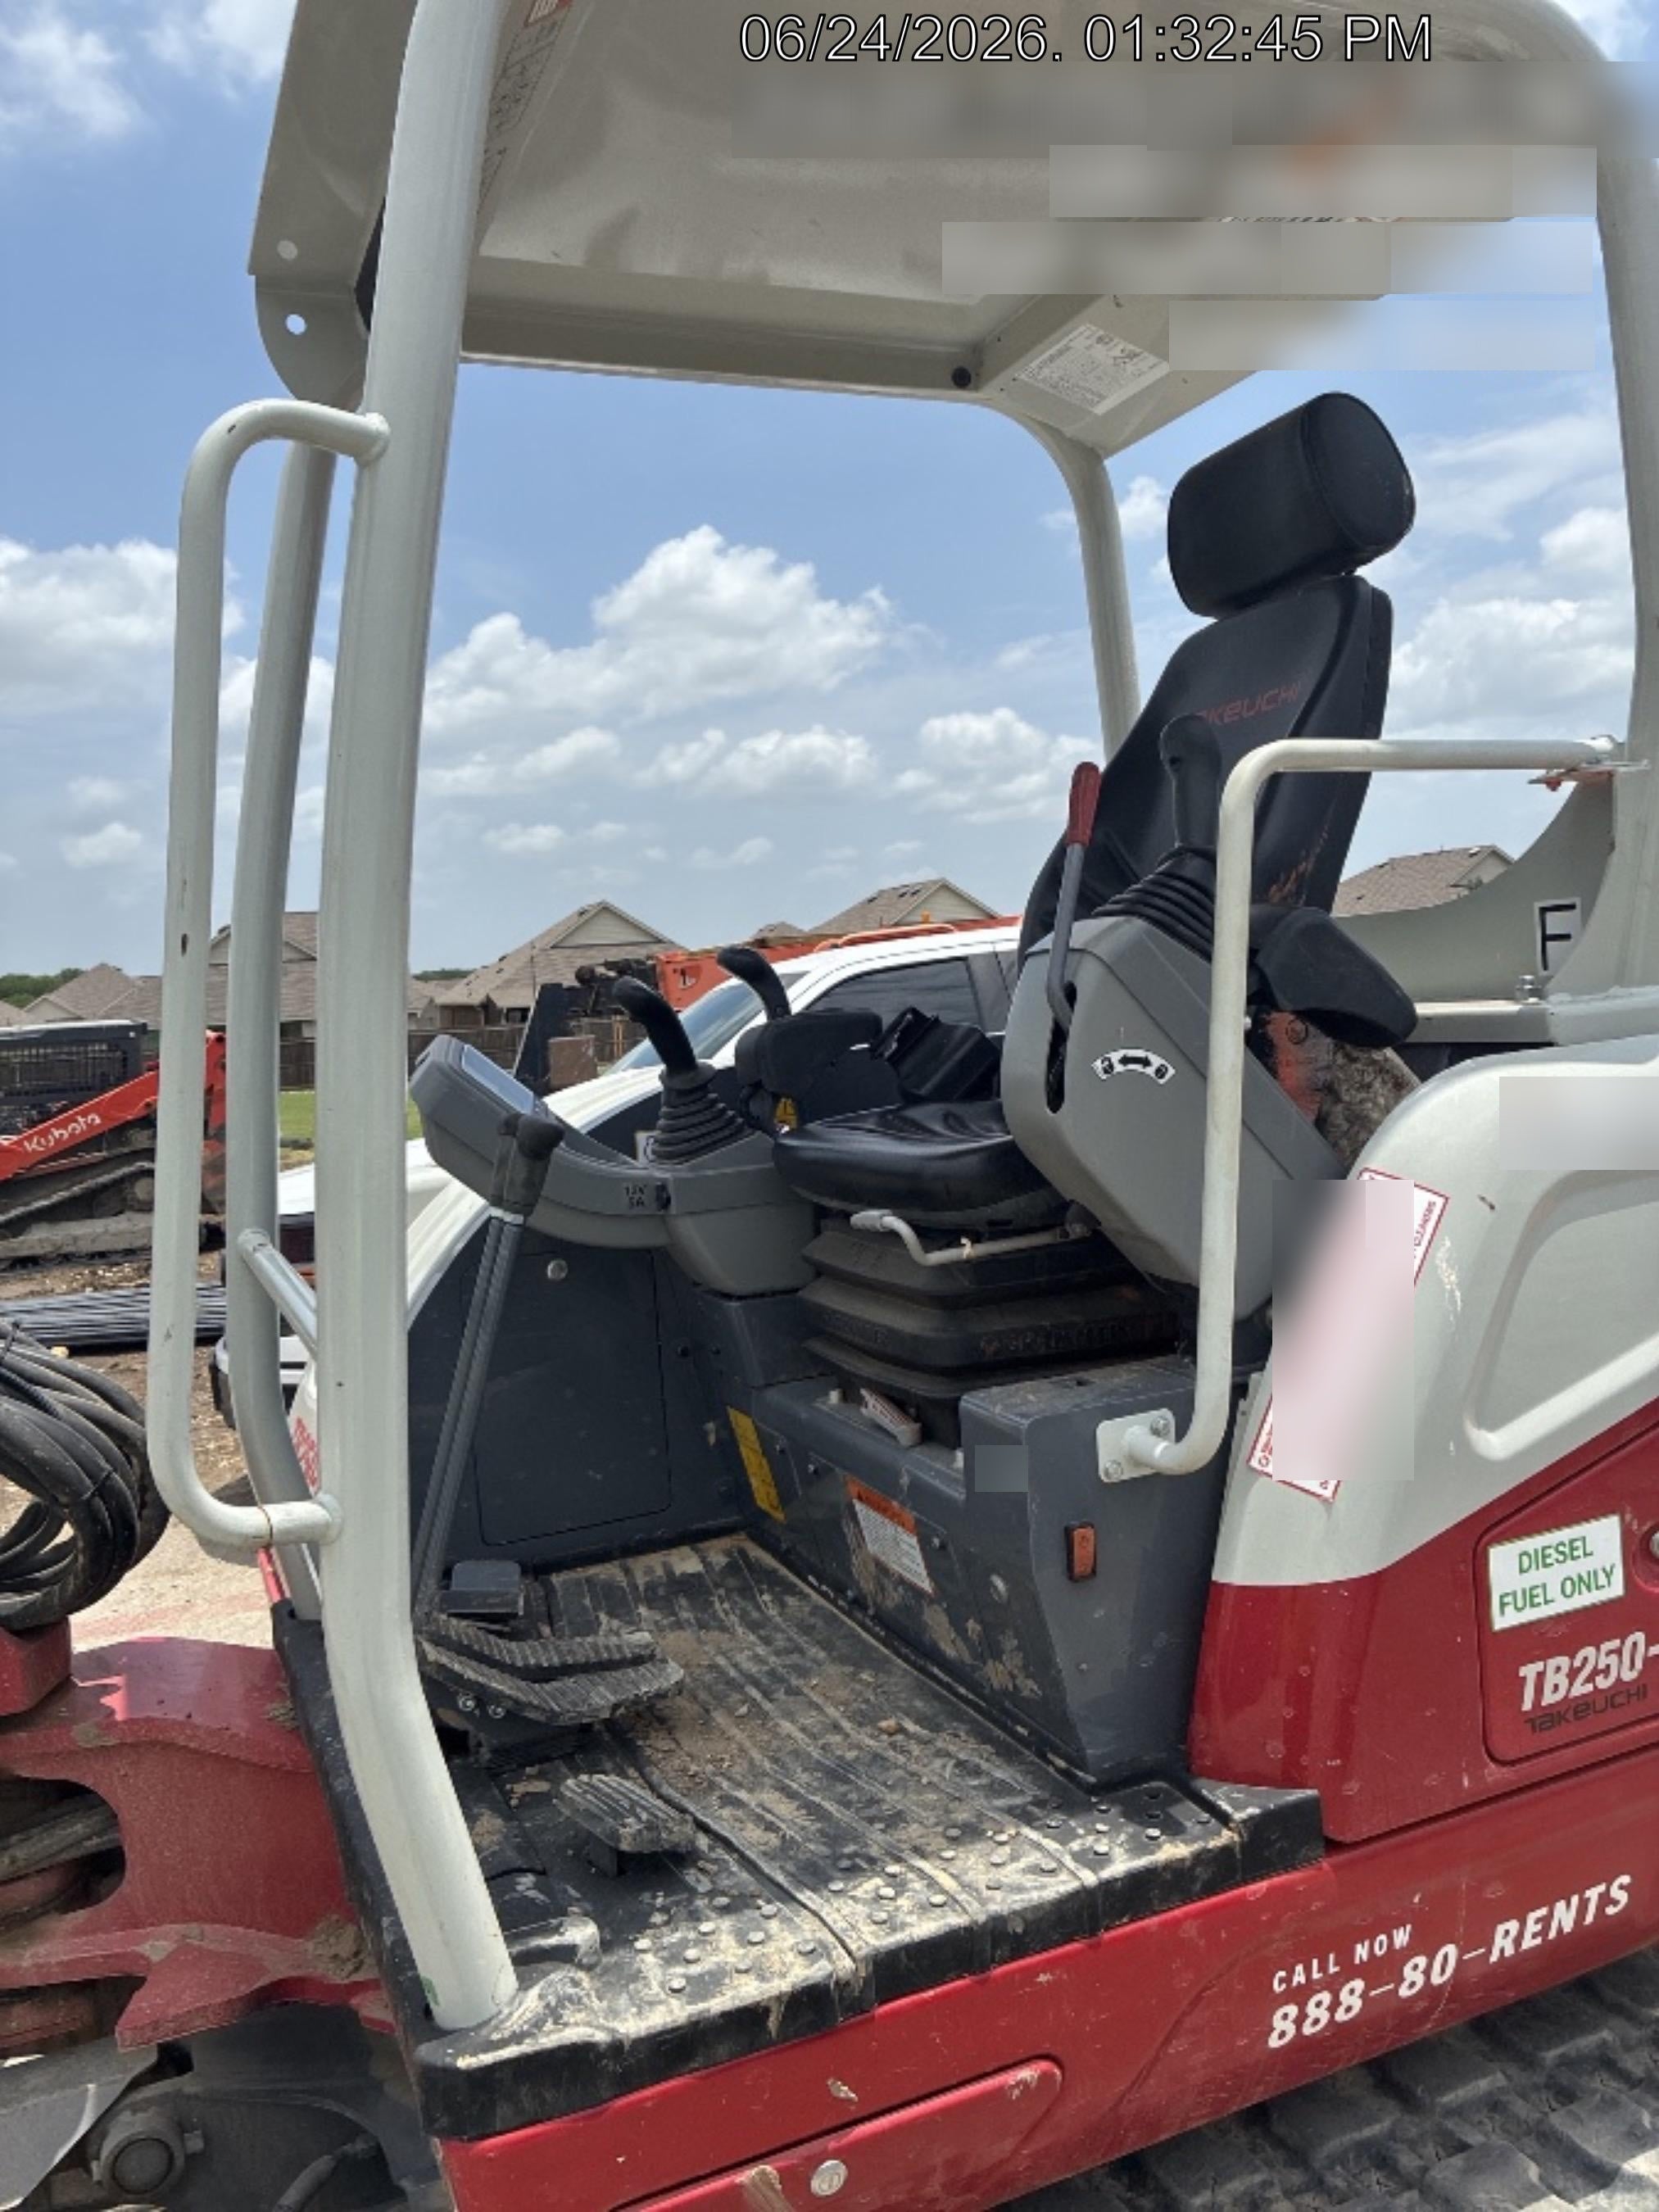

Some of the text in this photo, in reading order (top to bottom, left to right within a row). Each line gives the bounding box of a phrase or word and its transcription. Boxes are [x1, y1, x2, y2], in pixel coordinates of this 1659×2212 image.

[1539, 902, 1577, 972] F
[23, 1113, 102, 1154] Kubota
[1518, 1534, 1594, 1575] DIESEL
[1498, 1562, 1616, 1617] FUEL ONLY
[1271, 1924, 1413, 1994] CALL NOW
